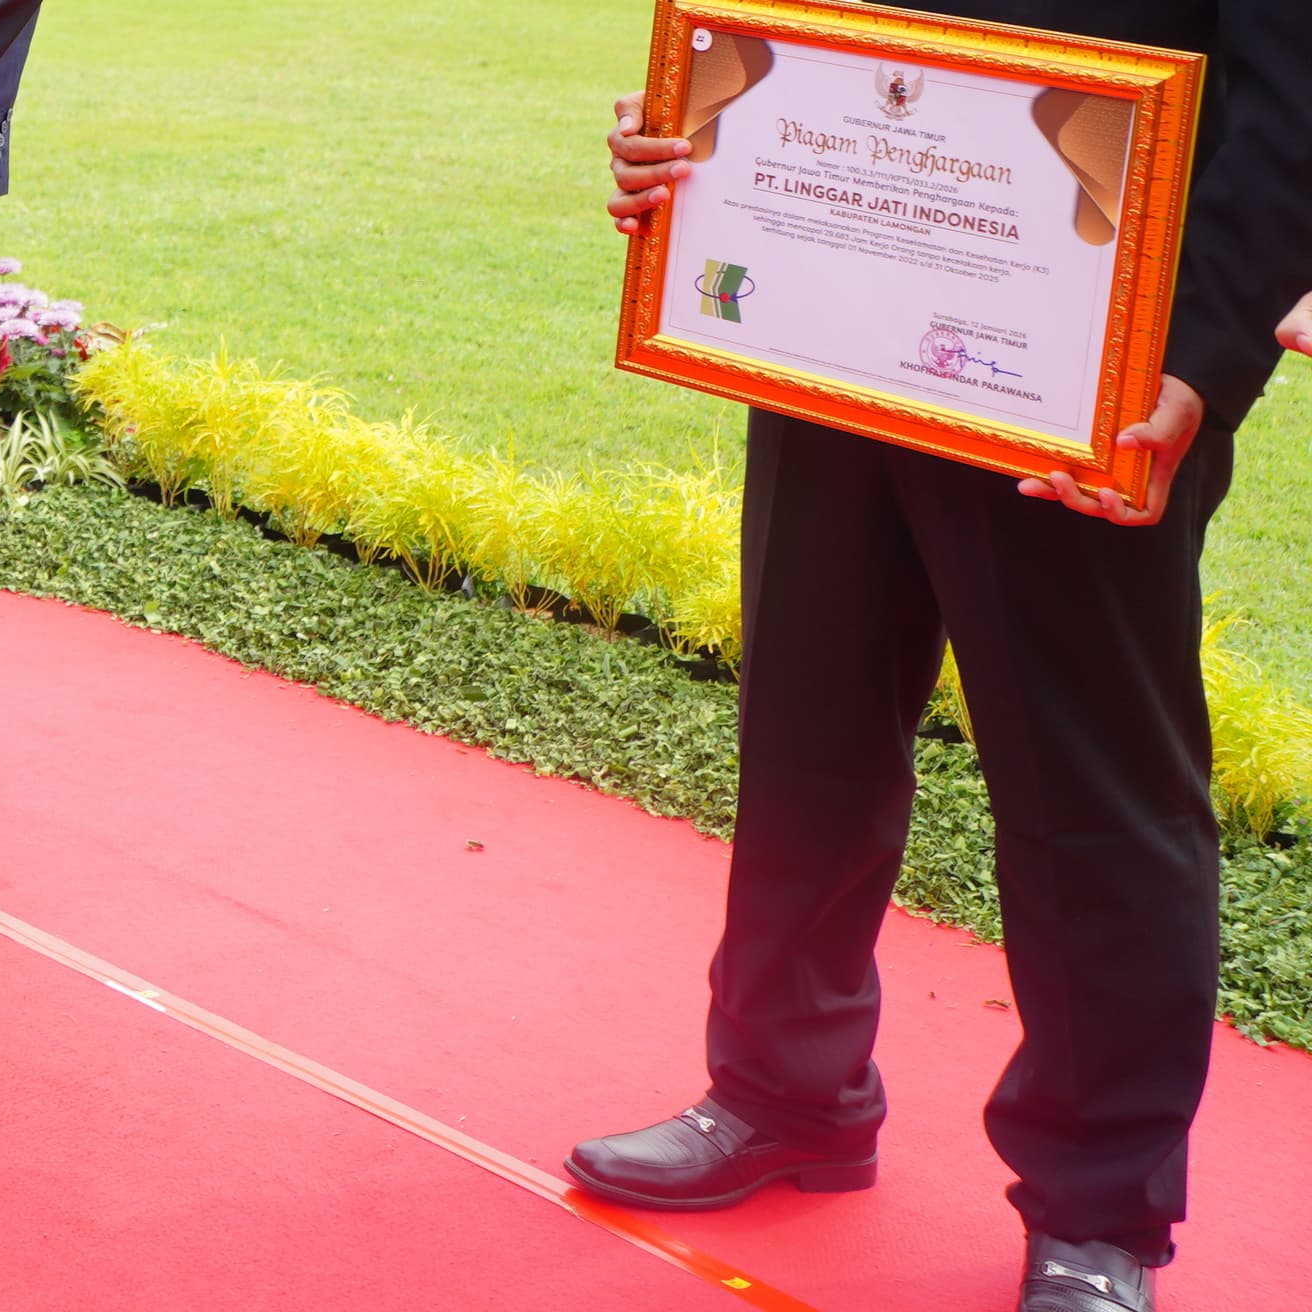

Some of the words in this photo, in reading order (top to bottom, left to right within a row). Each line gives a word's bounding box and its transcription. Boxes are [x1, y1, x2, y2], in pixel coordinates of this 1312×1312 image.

[843, 115, 889, 131] GUBERNUR
[893, 125, 916, 137] JAWA
[919, 130, 945, 143] TIMUR
[773, 117, 858, 161] Piagam
[863, 134, 1013, 191] Penghargaan
[816, 159, 840, 170] Nomor
[754, 156, 796, 173] Gubernur
[798, 165, 820, 178] Jawa
[823, 170, 849, 183] Timur
[852, 176, 909, 195] Memberikan
[912, 188, 975, 210] Penghargaan
[978, 201, 1019, 219] Kepada:
[754, 172, 779, 189] PT.
[784, 178, 863, 207] LINGGAR
[867, 195, 907, 216] JATI
[912, 204, 1020, 239] INDONESIA
[752, 214, 784, 227] sehingga
[786, 221, 822, 235] mencapai
[850, 235, 867, 244] Jam
[869, 239, 889, 250] Kerja
[891, 244, 914, 256] Orang
[916, 250, 939, 261] tanpa
[942, 255, 987, 271] kecelakaan
[830, 208, 878, 224] KABUPATEN
[880, 219, 930, 236] LAMONGAN
[796, 233, 814, 243] sejak
[858, 246, 896, 260] November
[944, 265, 976, 277] Oktober
[862, 228, 894, 242] Program
[896, 236, 946, 252] Keselamatan
[948, 247, 963, 255] dan
[965, 251, 1008, 265] Kesehatan
[1032, 264, 1048, 275] (K3)
[929, 320, 973, 337] GUBERNUR
[975, 331, 997, 343] JAWA
[1000, 337, 1028, 350] TIMUR
[949, 372, 978, 387] INDAR
[980, 380, 1042, 402] PARAWANSA
